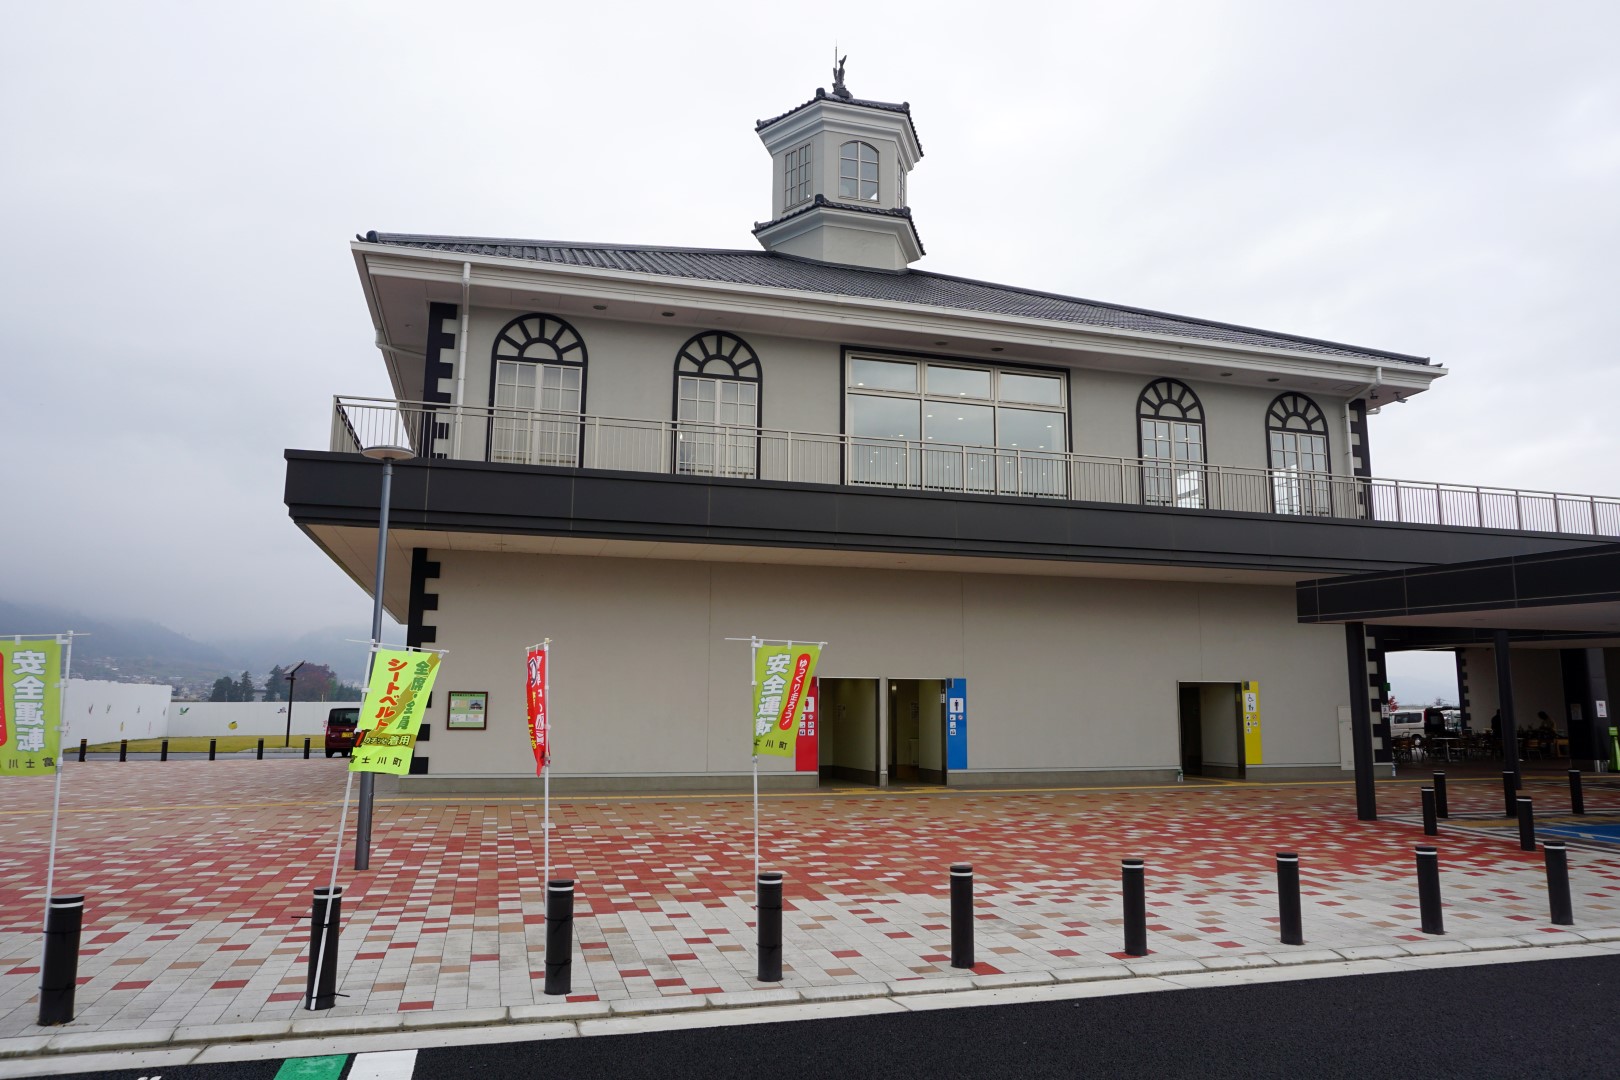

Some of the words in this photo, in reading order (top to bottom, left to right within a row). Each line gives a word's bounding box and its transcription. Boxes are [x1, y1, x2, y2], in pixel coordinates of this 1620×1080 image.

[375, 658, 408, 731] シートベルト
[754, 653, 792, 737] 安全運転
